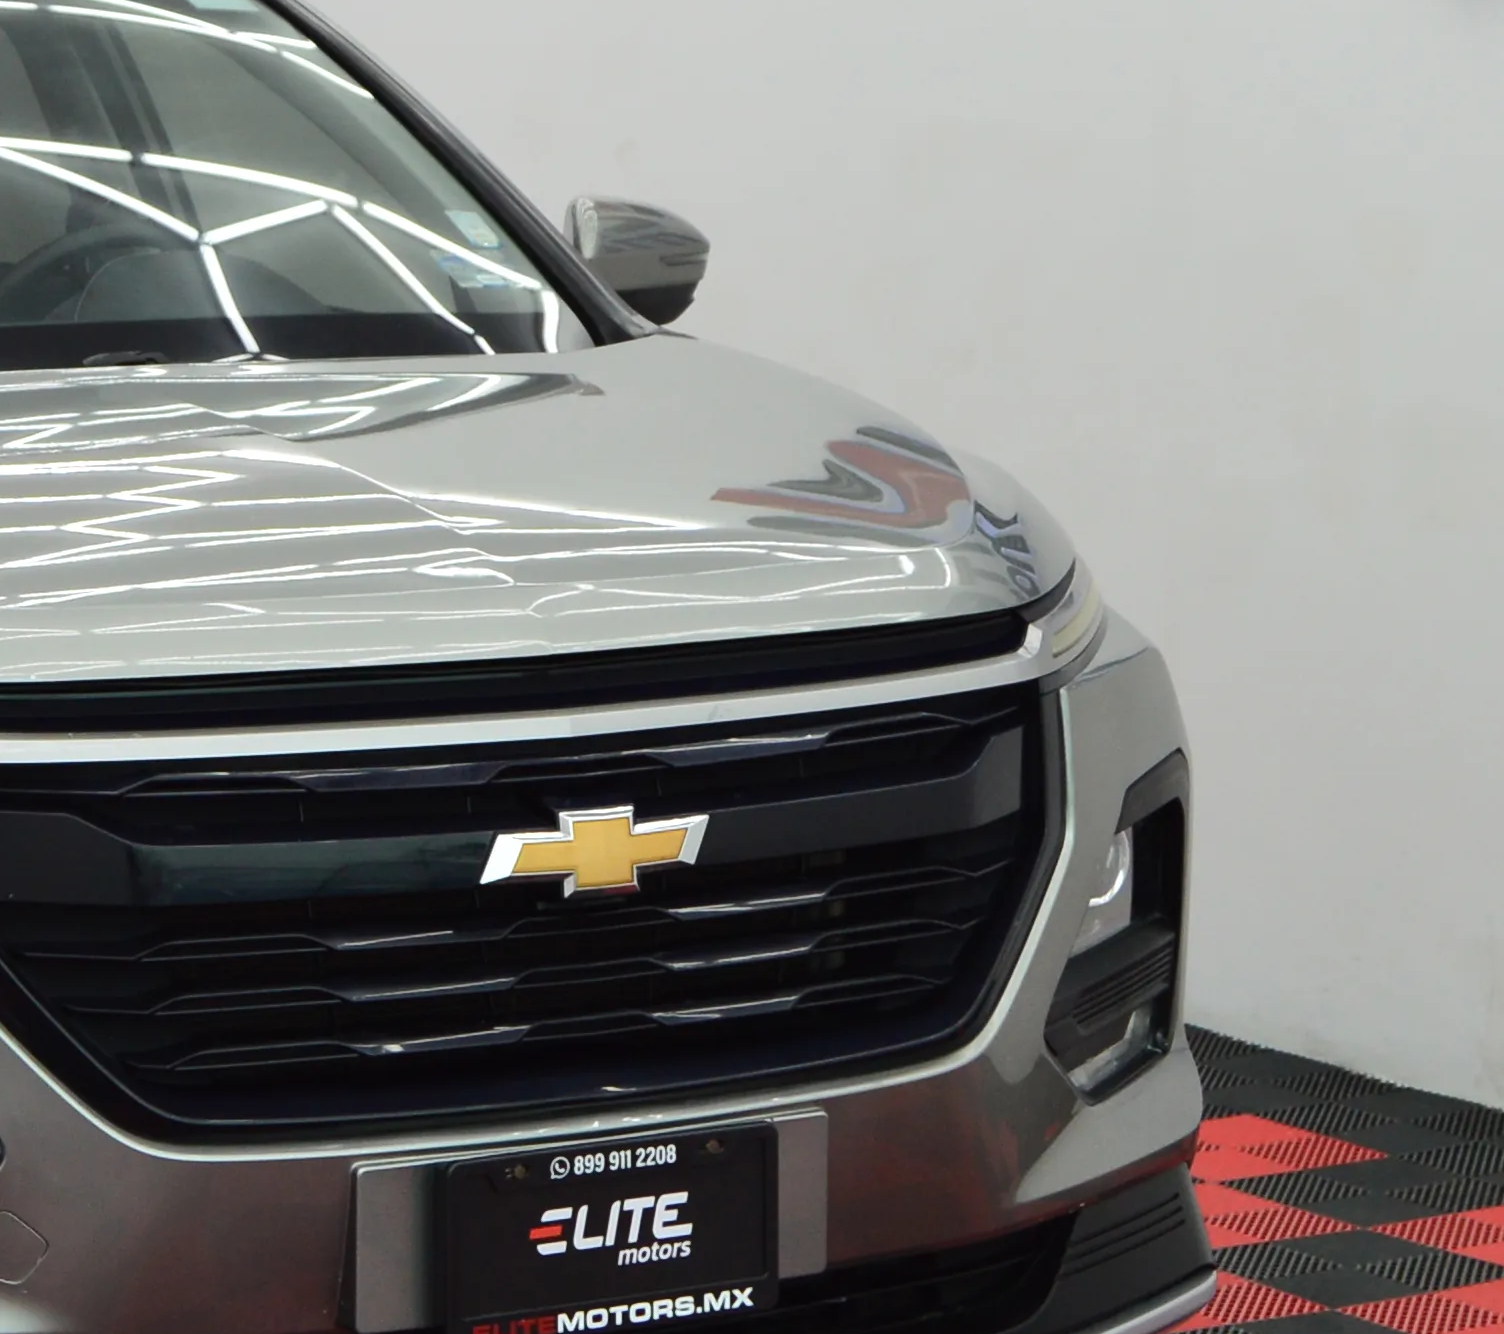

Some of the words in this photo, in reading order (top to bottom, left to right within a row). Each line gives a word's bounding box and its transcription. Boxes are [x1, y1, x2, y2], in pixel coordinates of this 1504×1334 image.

[573, 1151, 605, 1176] 899
[608, 1149, 633, 1172] 911
[635, 1144, 678, 1167] 2208
[529, 1190, 694, 1257] ELITE
[617, 1239, 692, 1267] motors
